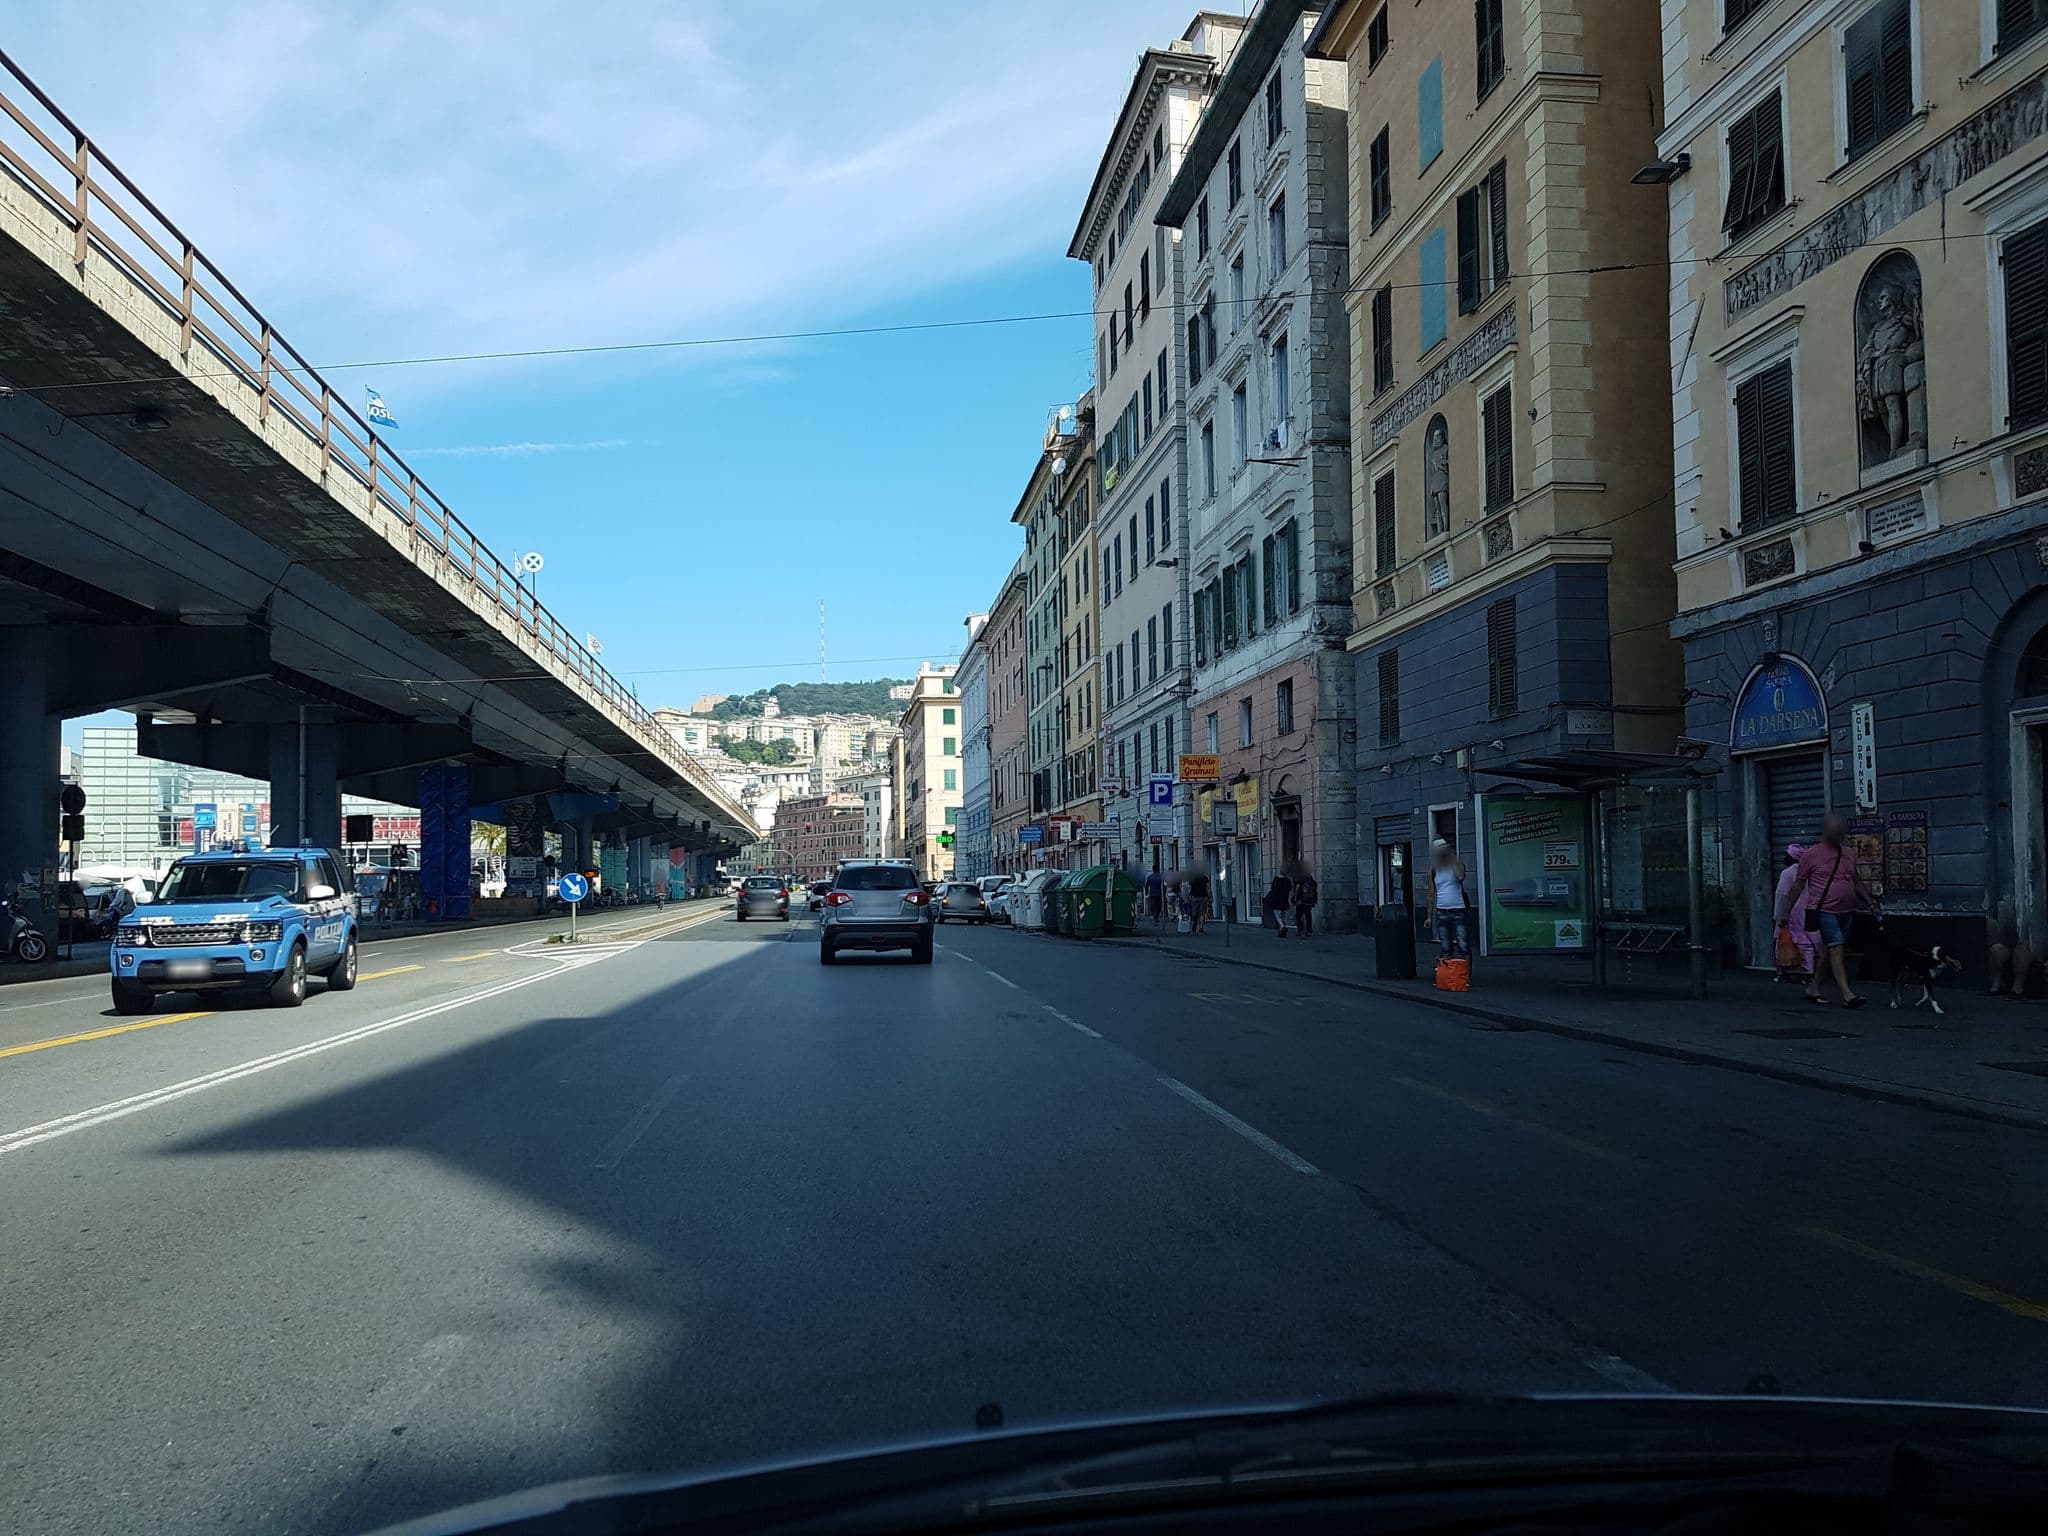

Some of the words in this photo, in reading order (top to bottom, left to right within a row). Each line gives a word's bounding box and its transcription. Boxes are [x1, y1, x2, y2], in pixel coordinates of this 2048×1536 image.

[1741, 718, 1756, 737] LA
[1760, 708, 1819, 734] DARSENA
[1181, 756, 1216, 767] Panificio
[1182, 767, 1216, 776] Gramsci
[1154, 784, 1169, 802] P
